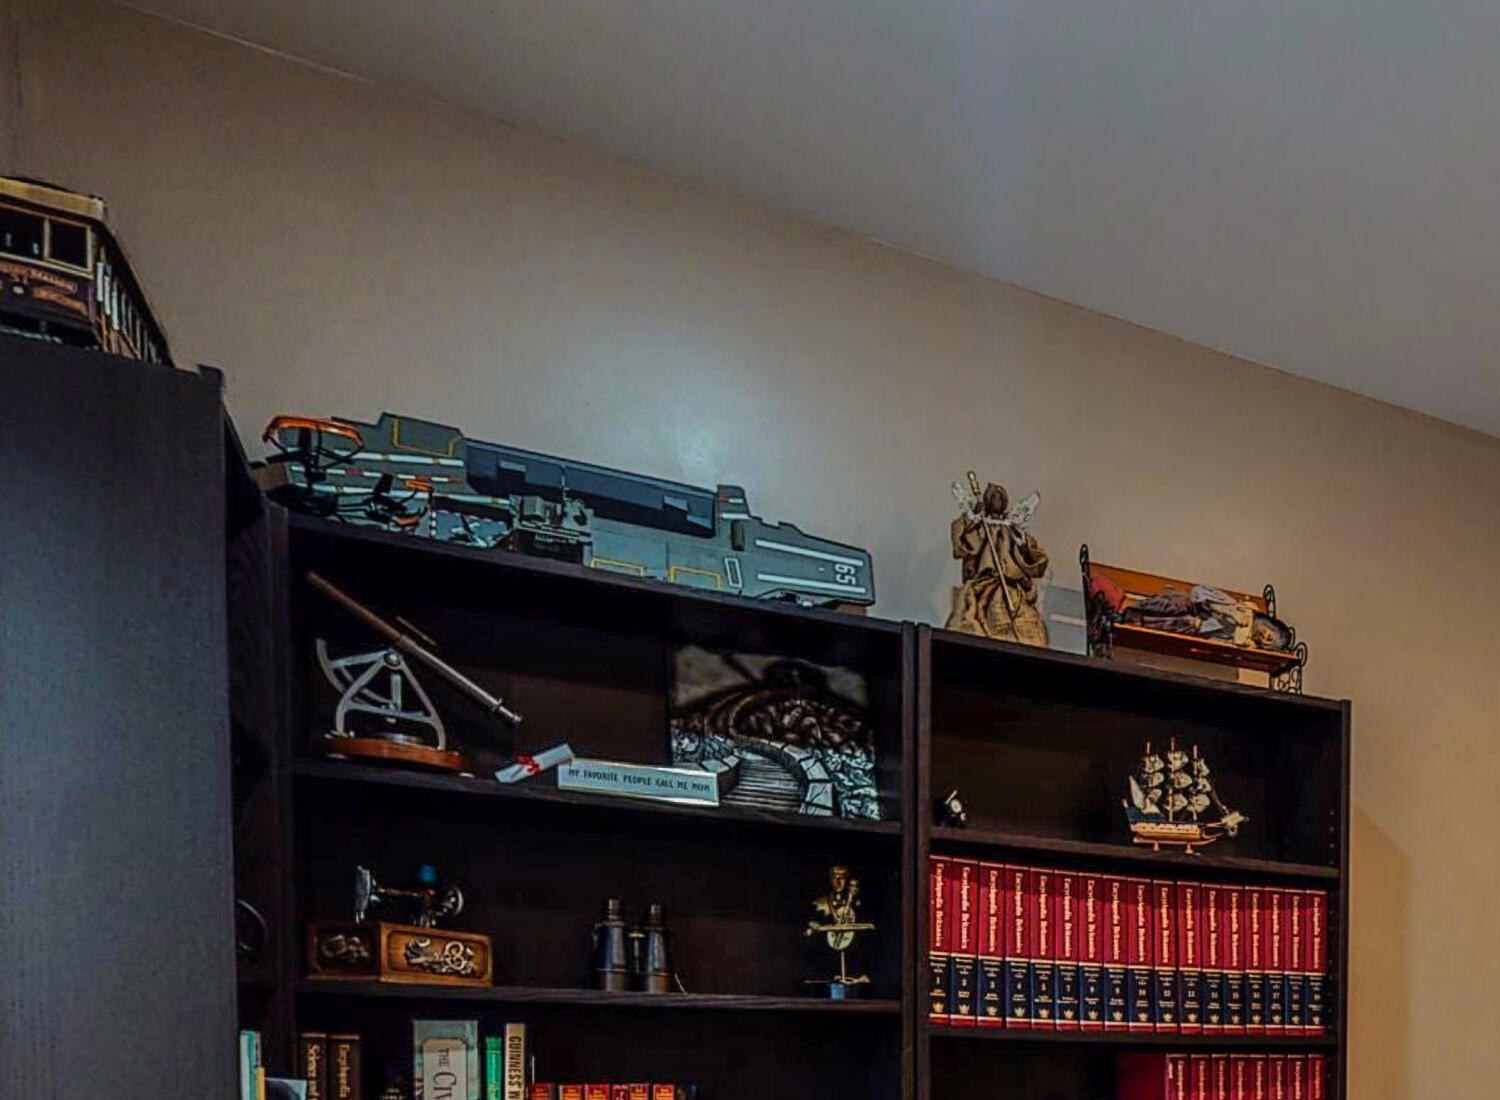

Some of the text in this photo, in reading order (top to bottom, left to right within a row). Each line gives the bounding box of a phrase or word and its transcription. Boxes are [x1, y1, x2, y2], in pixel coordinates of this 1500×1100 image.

[834, 563, 856, 586] 65
[583, 770, 618, 783] FAVORITE
[623, 774, 652, 786] PEOPLE
[655, 778, 674, 789] CALL
[677, 780, 688, 791] ME
[438, 1048, 451, 1067] THE
[508, 1035, 522, 1087] GUINNESS
